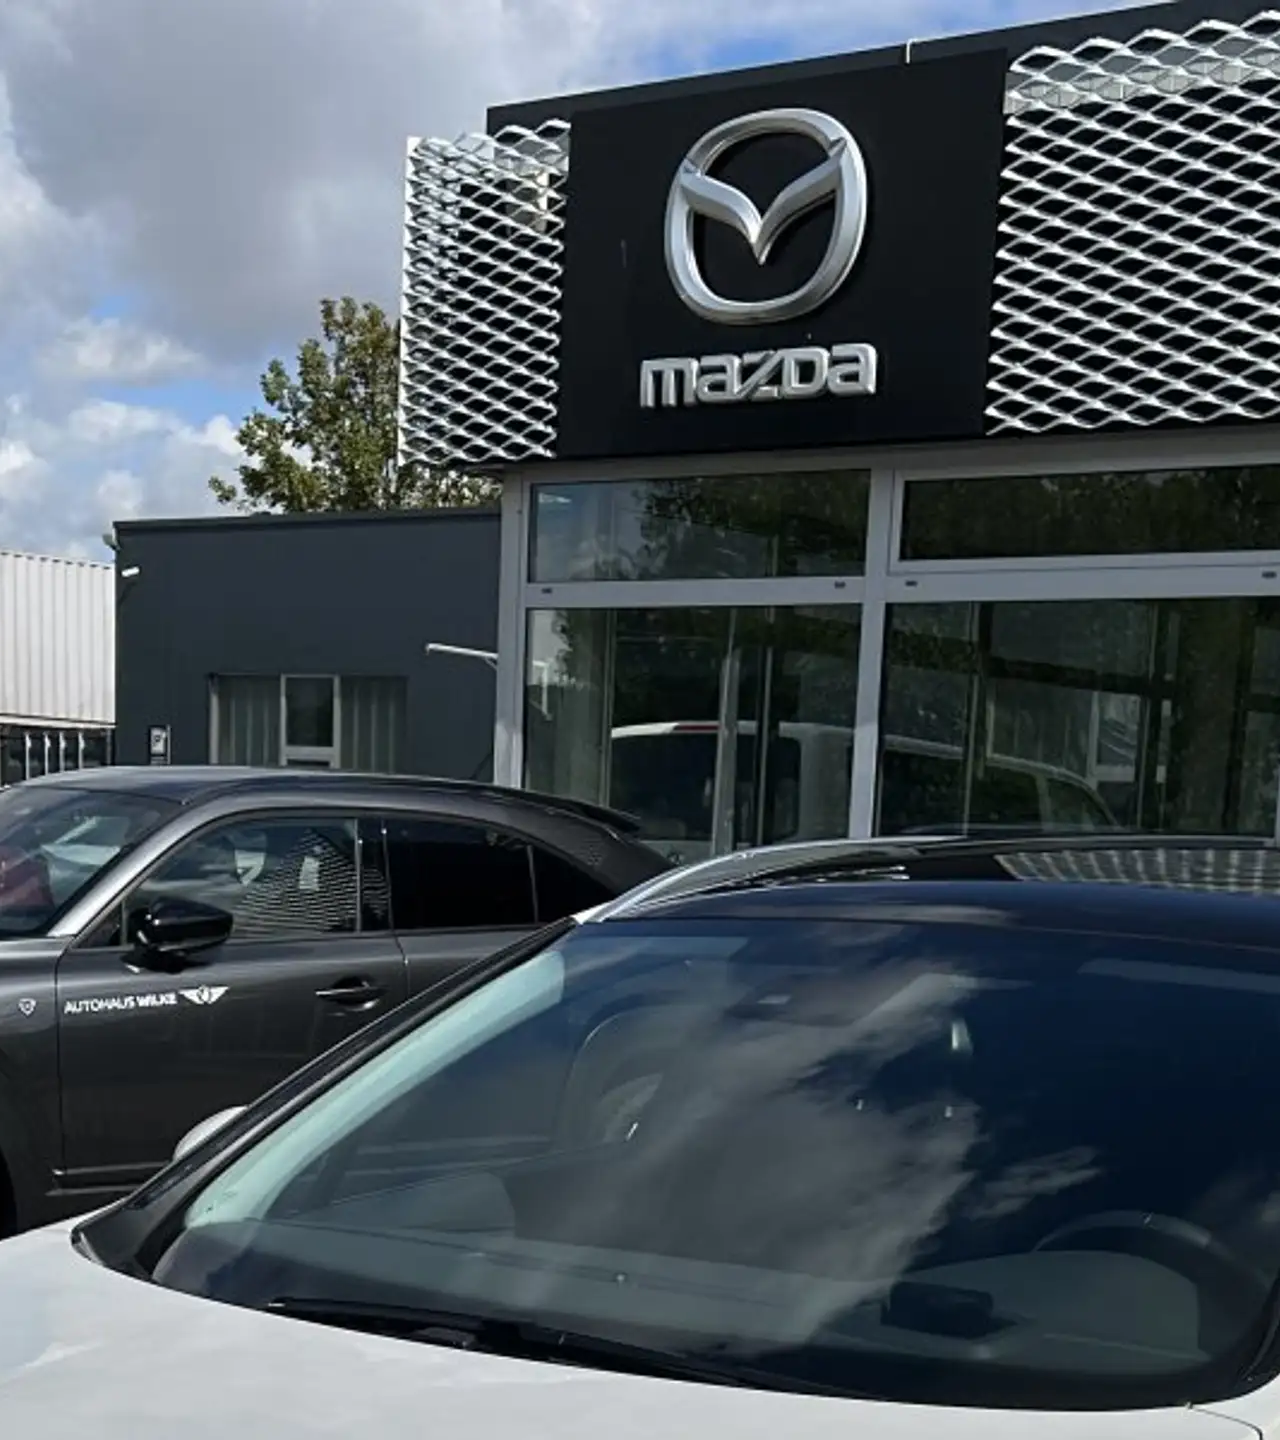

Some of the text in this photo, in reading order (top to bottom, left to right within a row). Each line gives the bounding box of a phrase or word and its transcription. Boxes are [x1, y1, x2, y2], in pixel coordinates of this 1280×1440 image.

[640, 342, 877, 408] mazda
[65, 992, 177, 1014] AUTOHAUS WILKE
